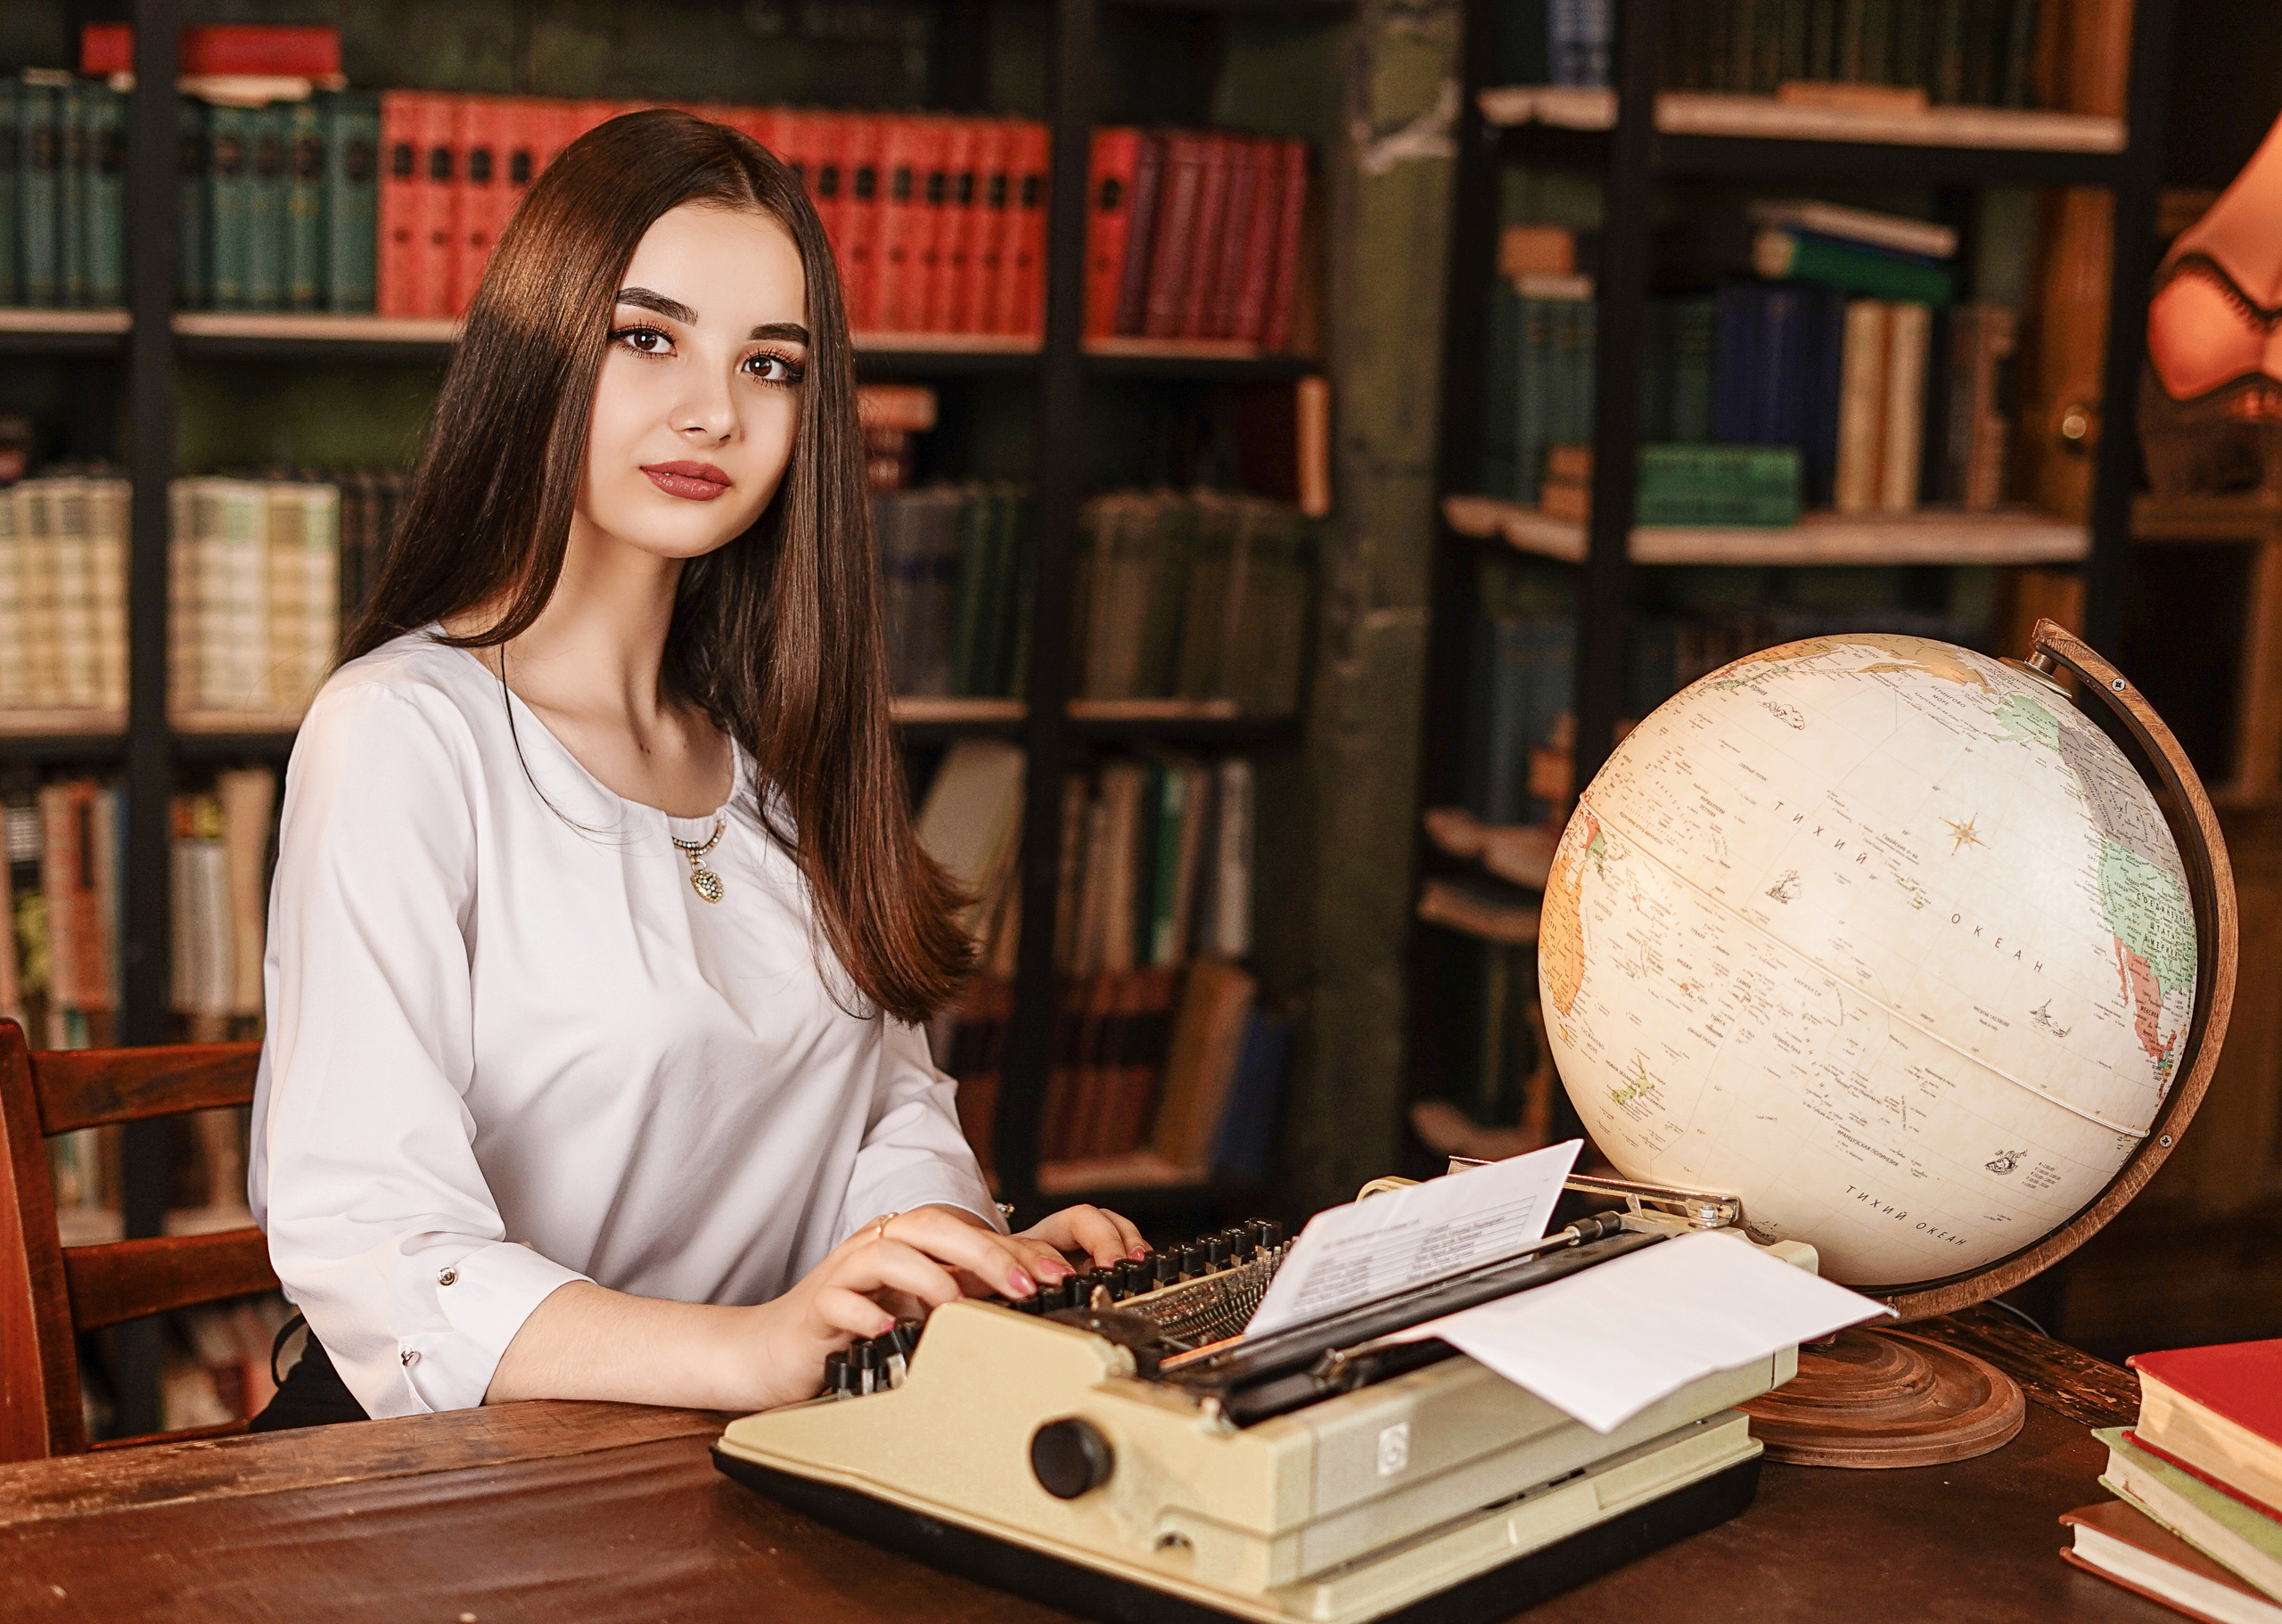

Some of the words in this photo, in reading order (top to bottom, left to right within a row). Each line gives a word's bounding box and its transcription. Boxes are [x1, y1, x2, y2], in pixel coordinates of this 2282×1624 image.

[1929, 684, 1966, 709] БЕРИНГОВО
[1931, 693, 1950, 707] МОРЕ
[1698, 803, 1716, 818] ОСТРОВА
[1699, 794, 1725, 815] МАРШАЛЛОВЫ
[1774, 800, 1867, 865] ТИХИЙ
[1900, 828, 1910, 837] 30°
[1880, 833, 1907, 852] Гавайские
[1904, 849, 1919, 860] о-ва
[1868, 873, 1877, 882] 20°
[2137, 892, 2189, 925] СОЕДИНЕННЫЕ
[1624, 931, 1641, 945] ВАНУАТУ
[1688, 926, 1705, 940] ТУВАЛУ
[2150, 923, 2175, 939] ШТАТЫ
[1951, 912, 2045, 974] ОКЕАН
[1675, 956, 1693, 972] ФИДЖИ
[1735, 977, 1752, 989] САМОА
[1792, 976, 1822, 997] КИРИБАТИ
[1972, 1005, 1990, 1017] МАСШТАБ
[2140, 1005, 2159, 1019] МЕКСИКА
[1709, 1013, 1727, 1027] ТОНГА
[1977, 1018, 1988, 1026] Made
[1686, 1026, 1702, 1039] ЮЖНЫЙ
[1700, 1035, 1717, 1049] ТРОПИК
[1769, 1031, 1792, 1047] Острова
[1788, 1044, 1802, 1055] Кука
[1603, 1059, 1620, 1072] НОВАЯ
[1835, 1128, 1871, 1152] ФРАНЦУЗСКАЯ
[1869, 1147, 1899, 1168] ПОЛИНЕЗИЯ
[1845, 1185, 1909, 1221] ТИХИЙ
[1915, 1221, 1967, 1247] ОКЕАН
